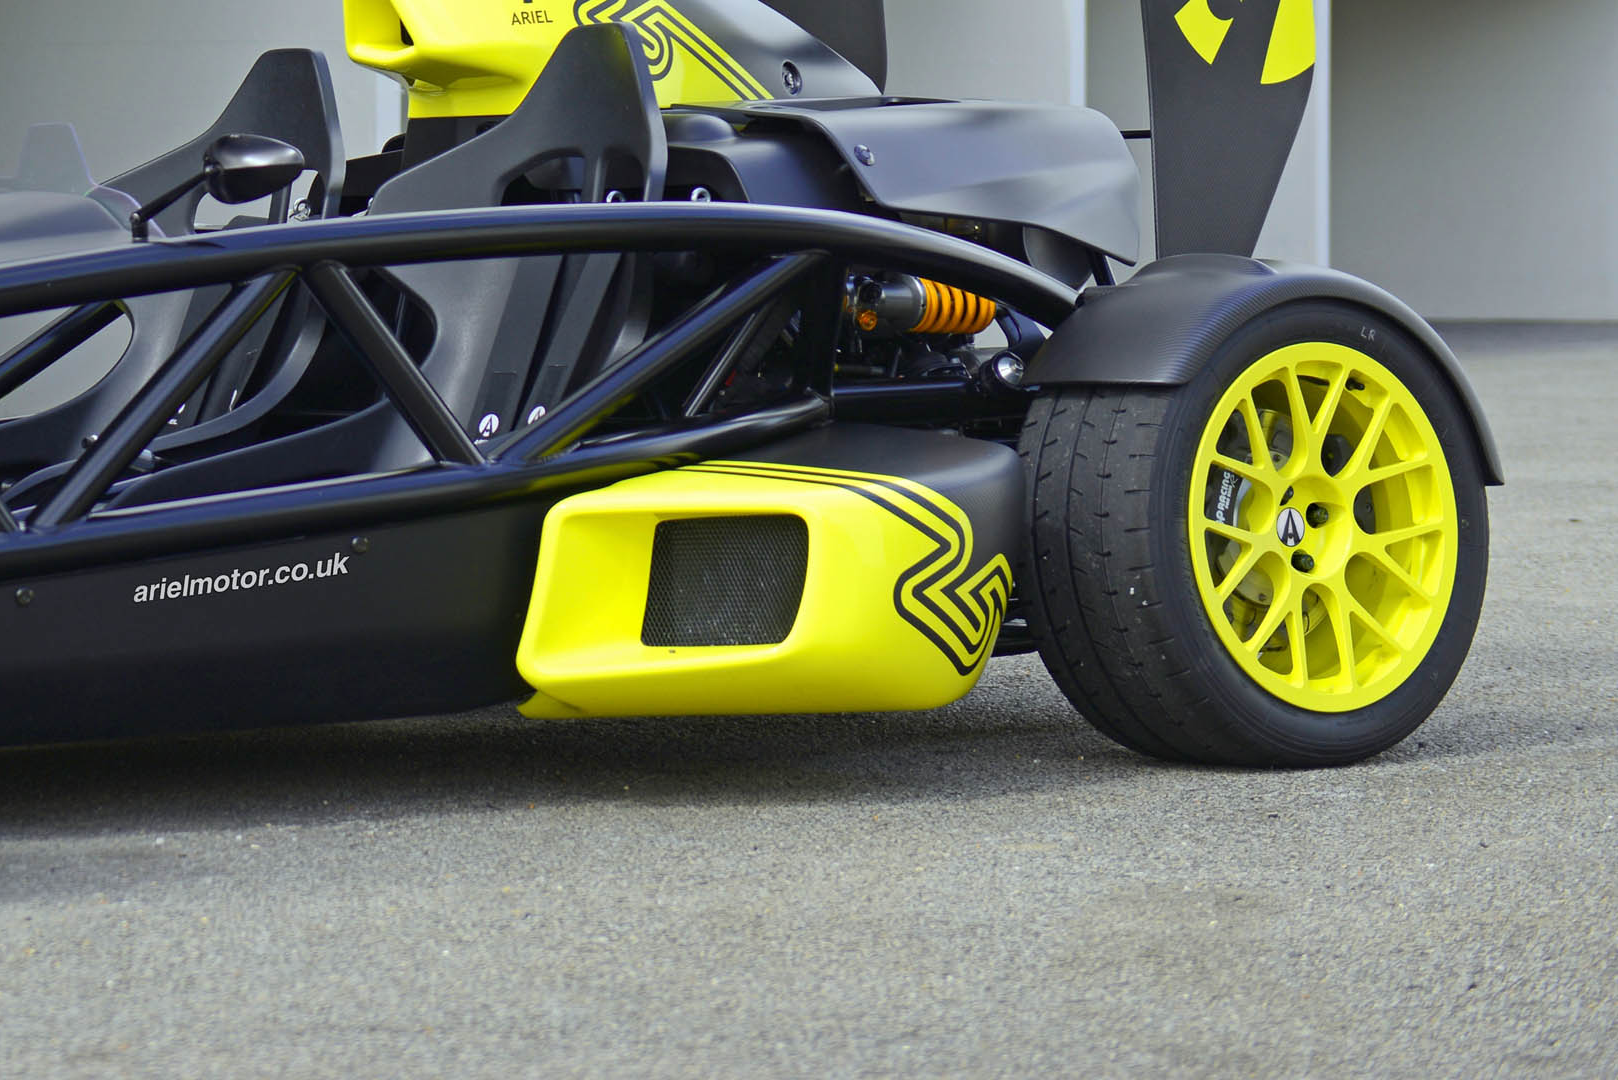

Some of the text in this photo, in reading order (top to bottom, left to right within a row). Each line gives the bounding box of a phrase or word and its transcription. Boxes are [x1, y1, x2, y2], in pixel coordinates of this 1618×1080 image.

[511, 10, 553, 26] ARIEL
[1217, 471, 1231, 511] RACING
[133, 552, 350, 603] arielmotor.co.uk
